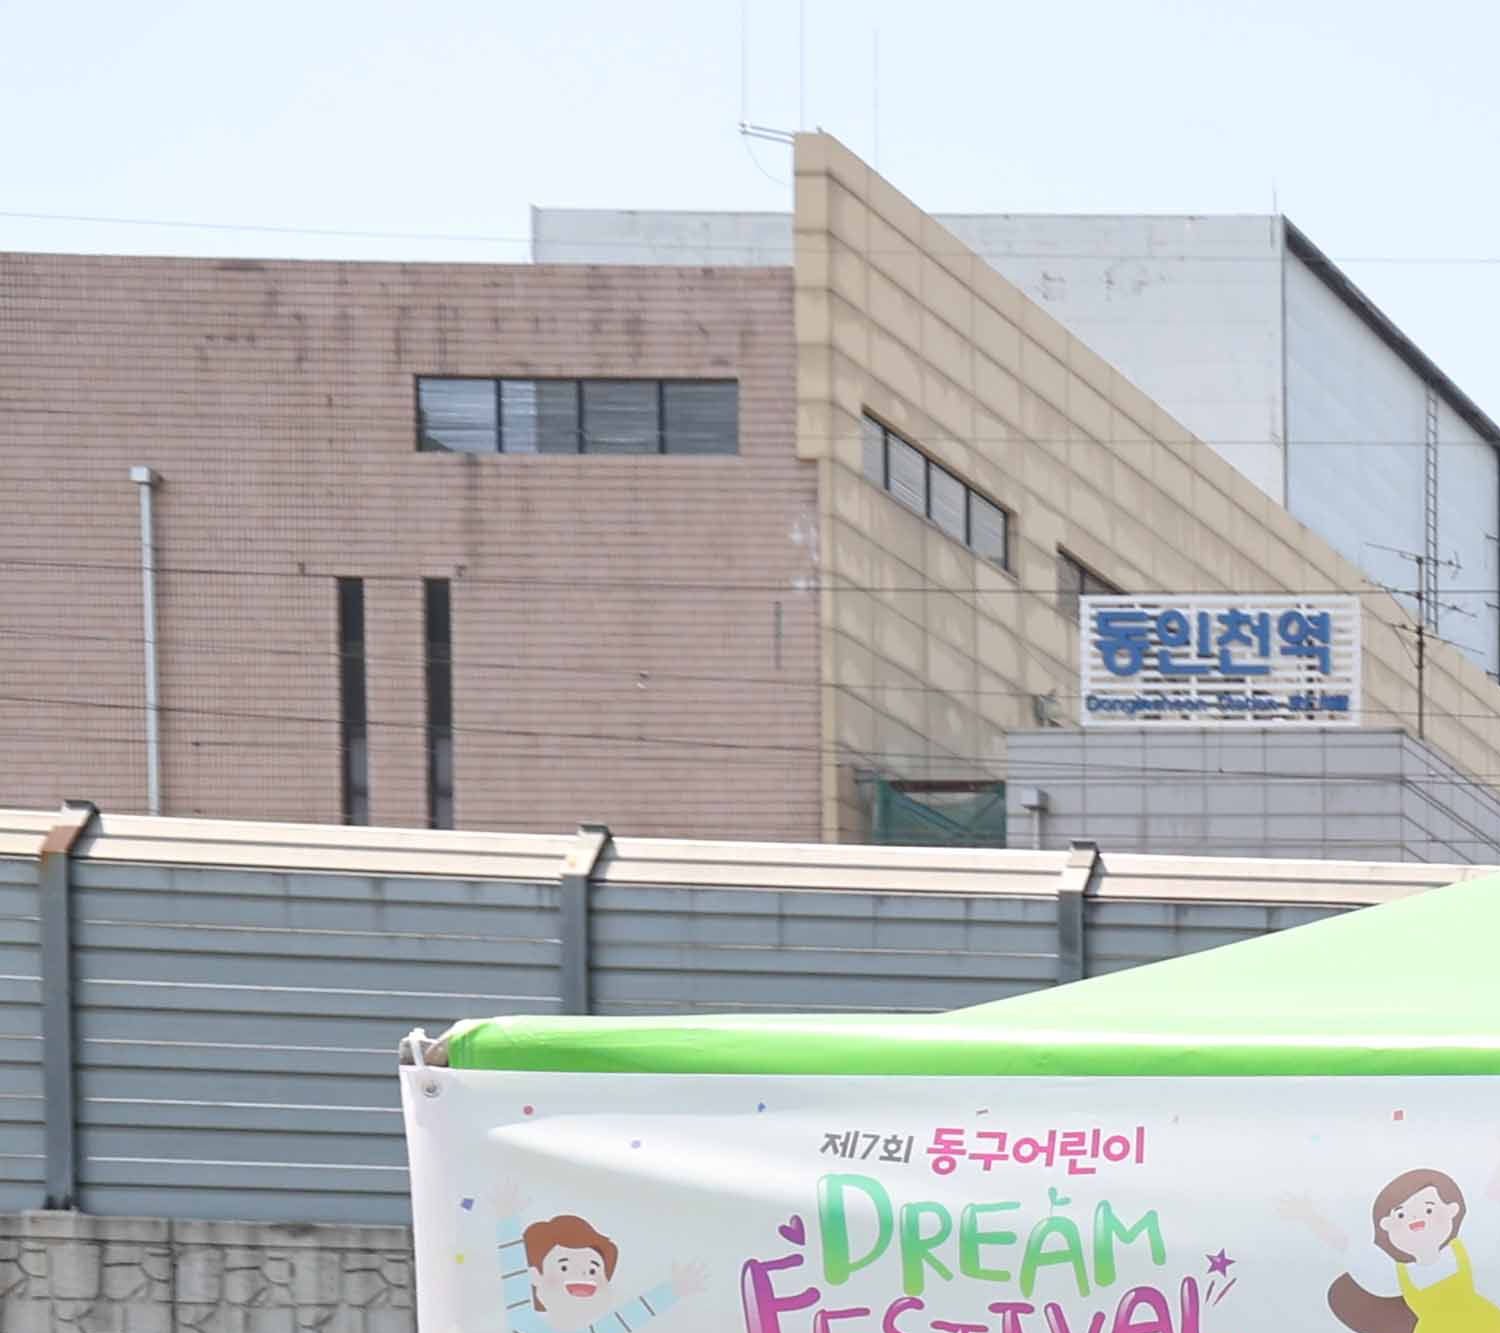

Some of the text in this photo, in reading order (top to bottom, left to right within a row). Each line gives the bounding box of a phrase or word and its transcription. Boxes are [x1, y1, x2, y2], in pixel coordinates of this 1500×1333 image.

[1095, 609, 1332, 676] 동인천역
[819, 1122, 1146, 1176] 제7회 동구어린이
[816, 1173, 1168, 1300] DREAM
